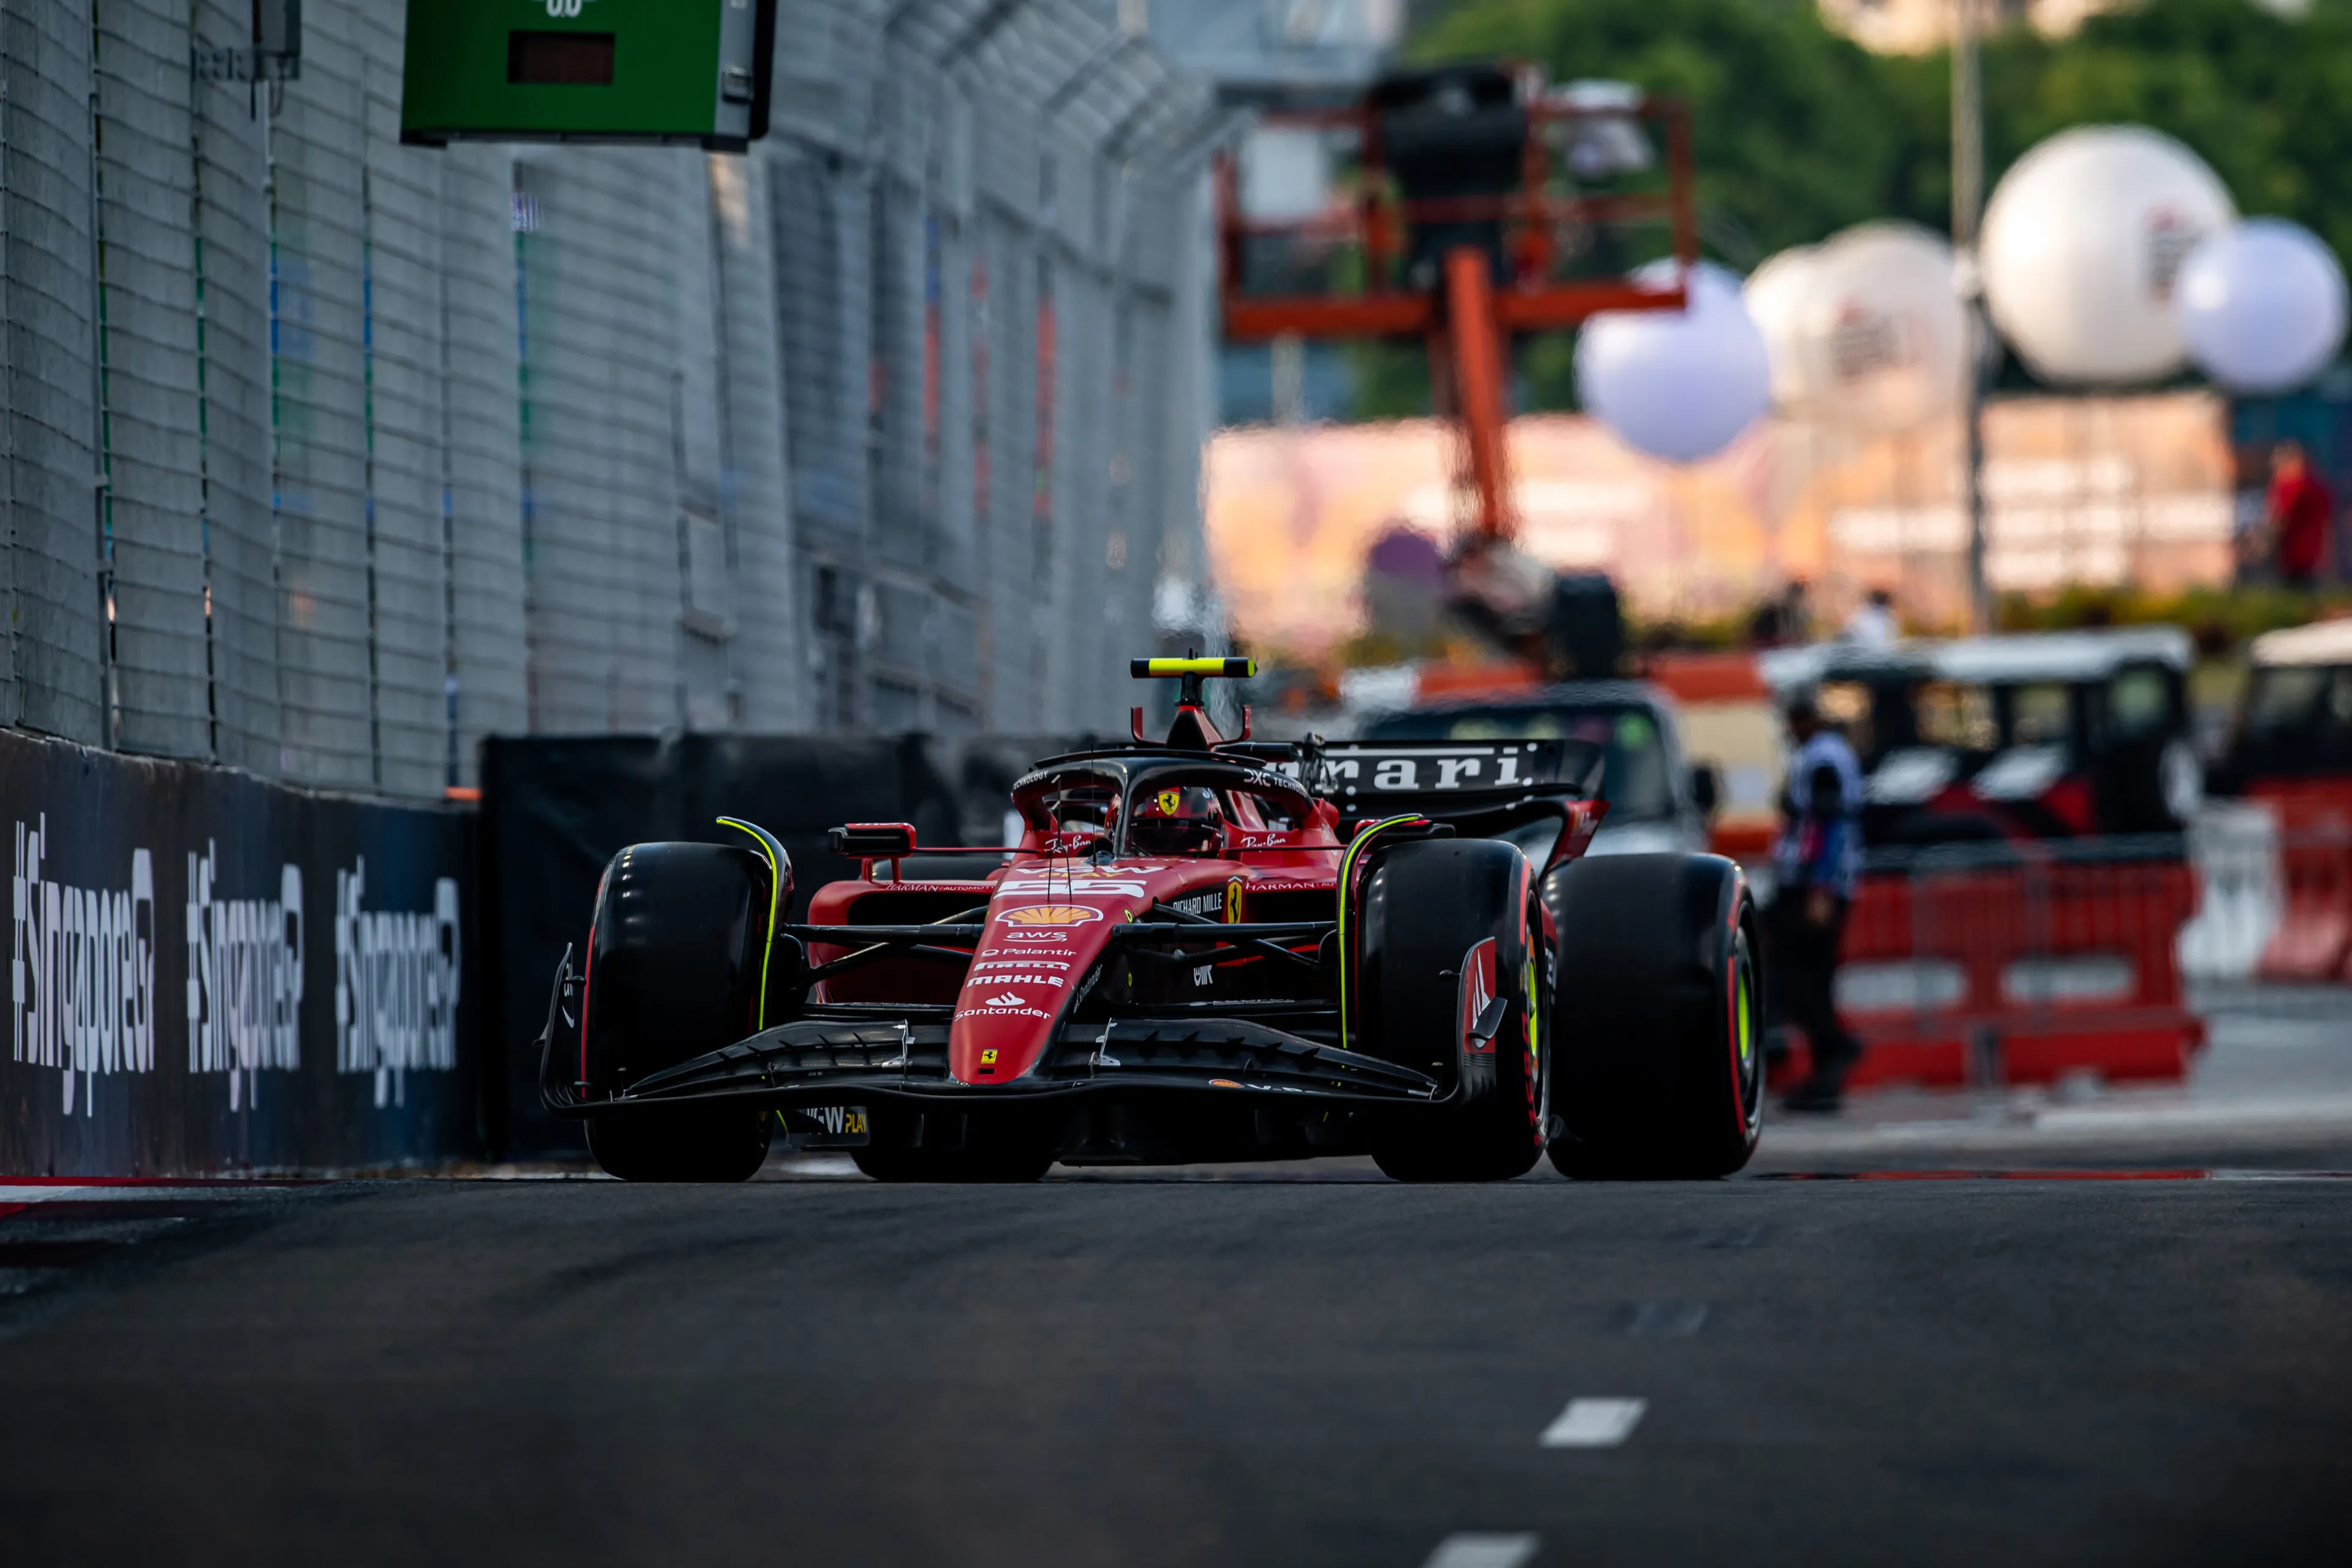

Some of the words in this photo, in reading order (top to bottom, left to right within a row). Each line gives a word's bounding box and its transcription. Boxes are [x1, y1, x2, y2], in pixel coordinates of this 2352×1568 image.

[1243, 768, 1272, 788] DXC
[1015, 865, 1164, 875] VGW
[886, 883, 938, 893] HARMAN
[993, 880, 1147, 899] 55
[1245, 882, 1314, 891] HARMAN
[1203, 892, 1223, 913] MILLE
[1002, 948, 1077, 956] Palantir
[973, 960, 1071, 971] PIRELLI
[967, 975, 1065, 988] MAHLE
[954, 1007, 1052, 1022] Santander
[845, 1114, 867, 1134] PLAY
